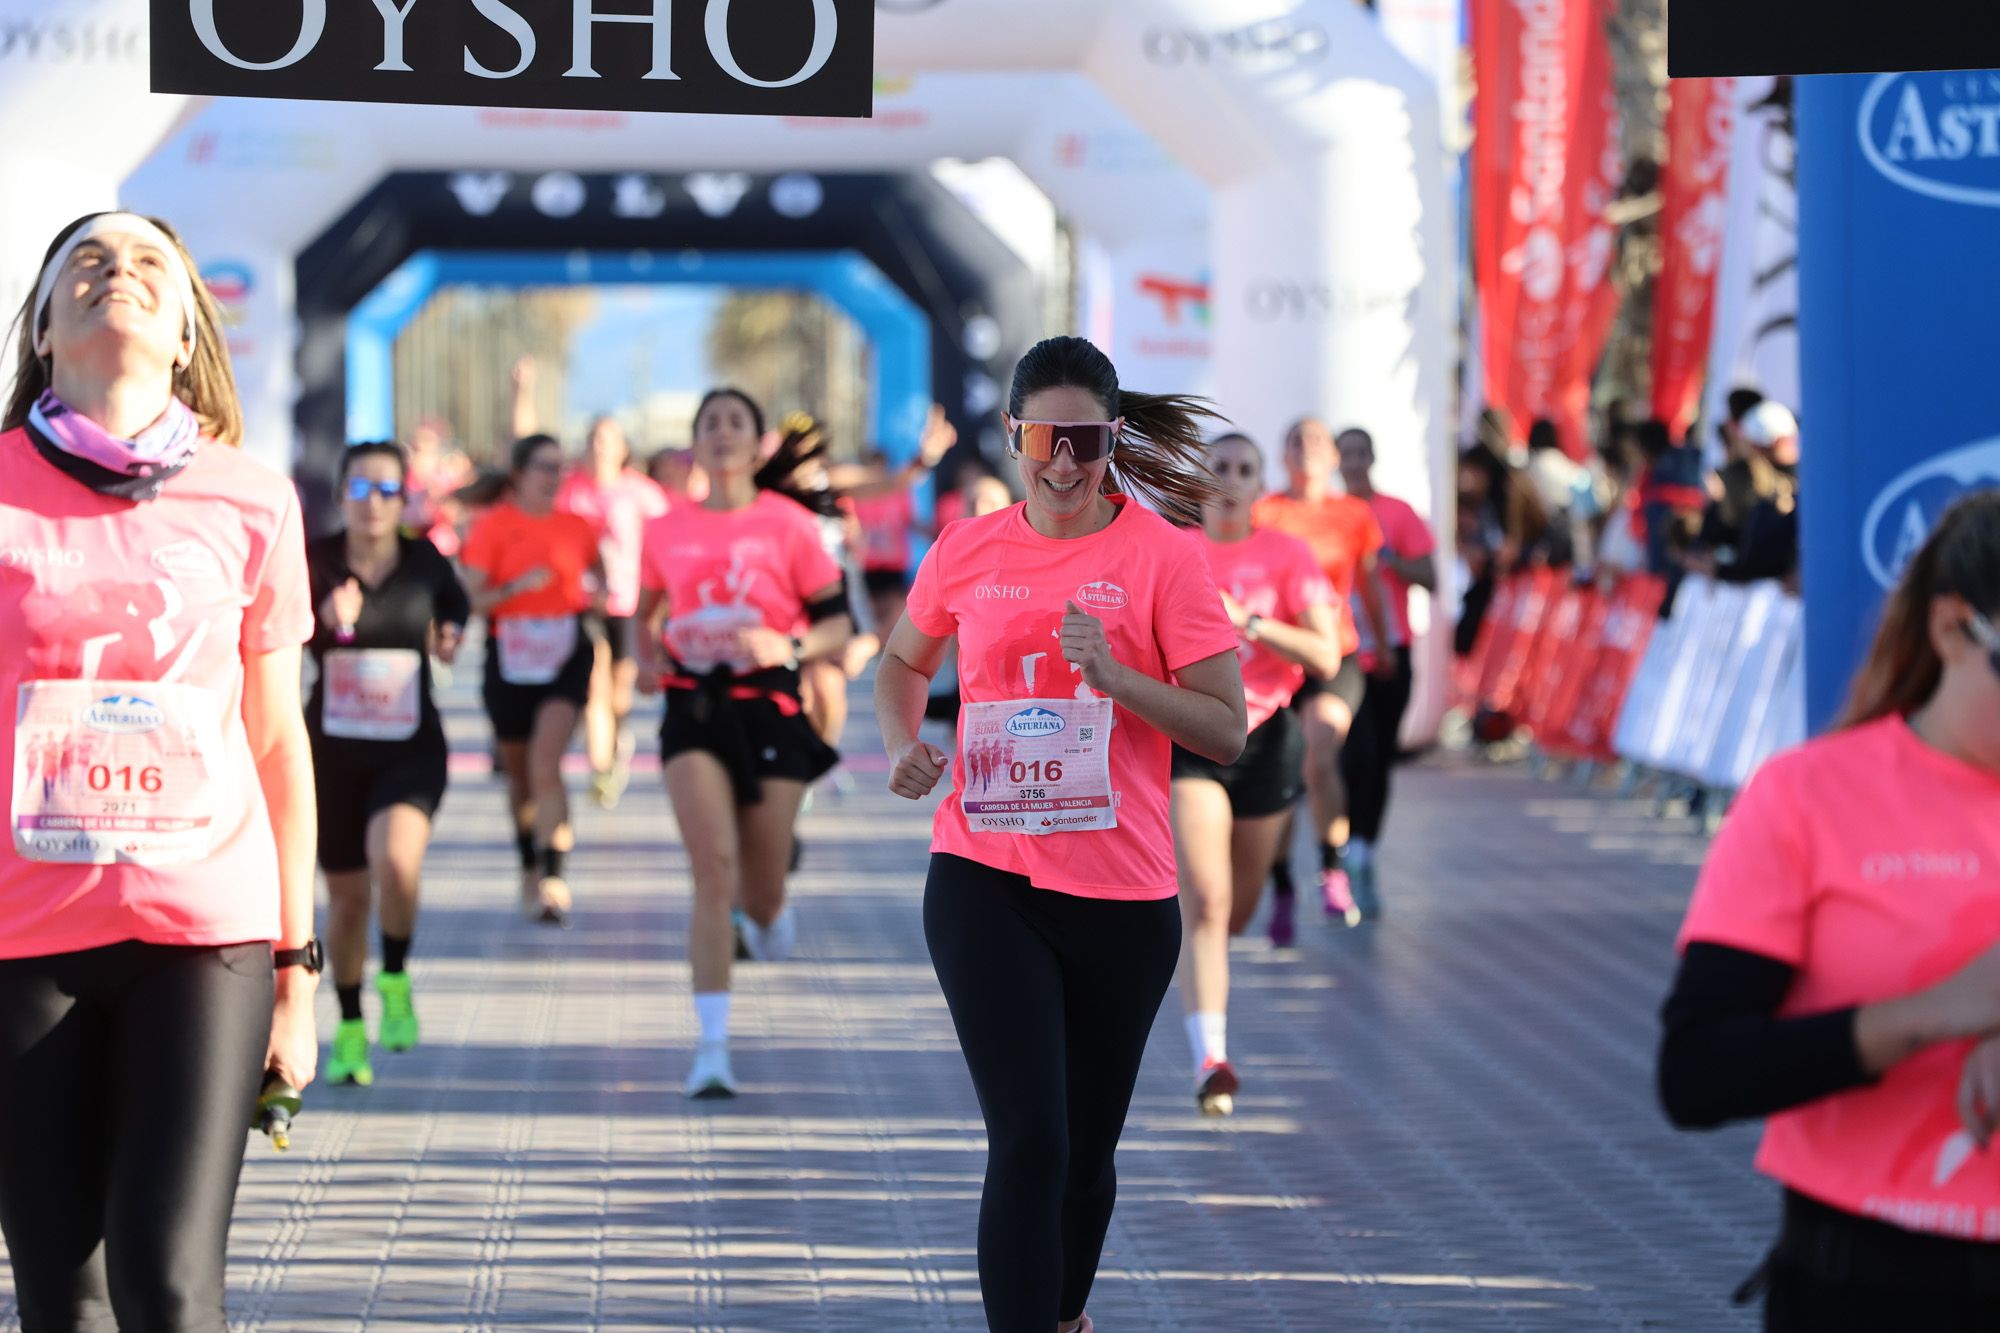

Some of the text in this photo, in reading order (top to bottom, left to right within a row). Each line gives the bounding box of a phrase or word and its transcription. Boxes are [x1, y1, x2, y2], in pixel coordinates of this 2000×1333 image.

[189, 0, 837, 88] OYSHO
[975, 584, 1030, 600] OYSHO
[1009, 718, 1062, 732] ASTURIANA
[88, 764, 163, 793] 016
[1009, 760, 1064, 784] 016
[1019, 788, 1046, 799] 3756
[101, 801, 137, 813] 2971
[980, 798, 1092, 812] CARRERA DE LA MUJER VALENCIA
[981, 814, 1098, 827] OYSHO Santander
[36, 838, 100, 852] OYSHO
